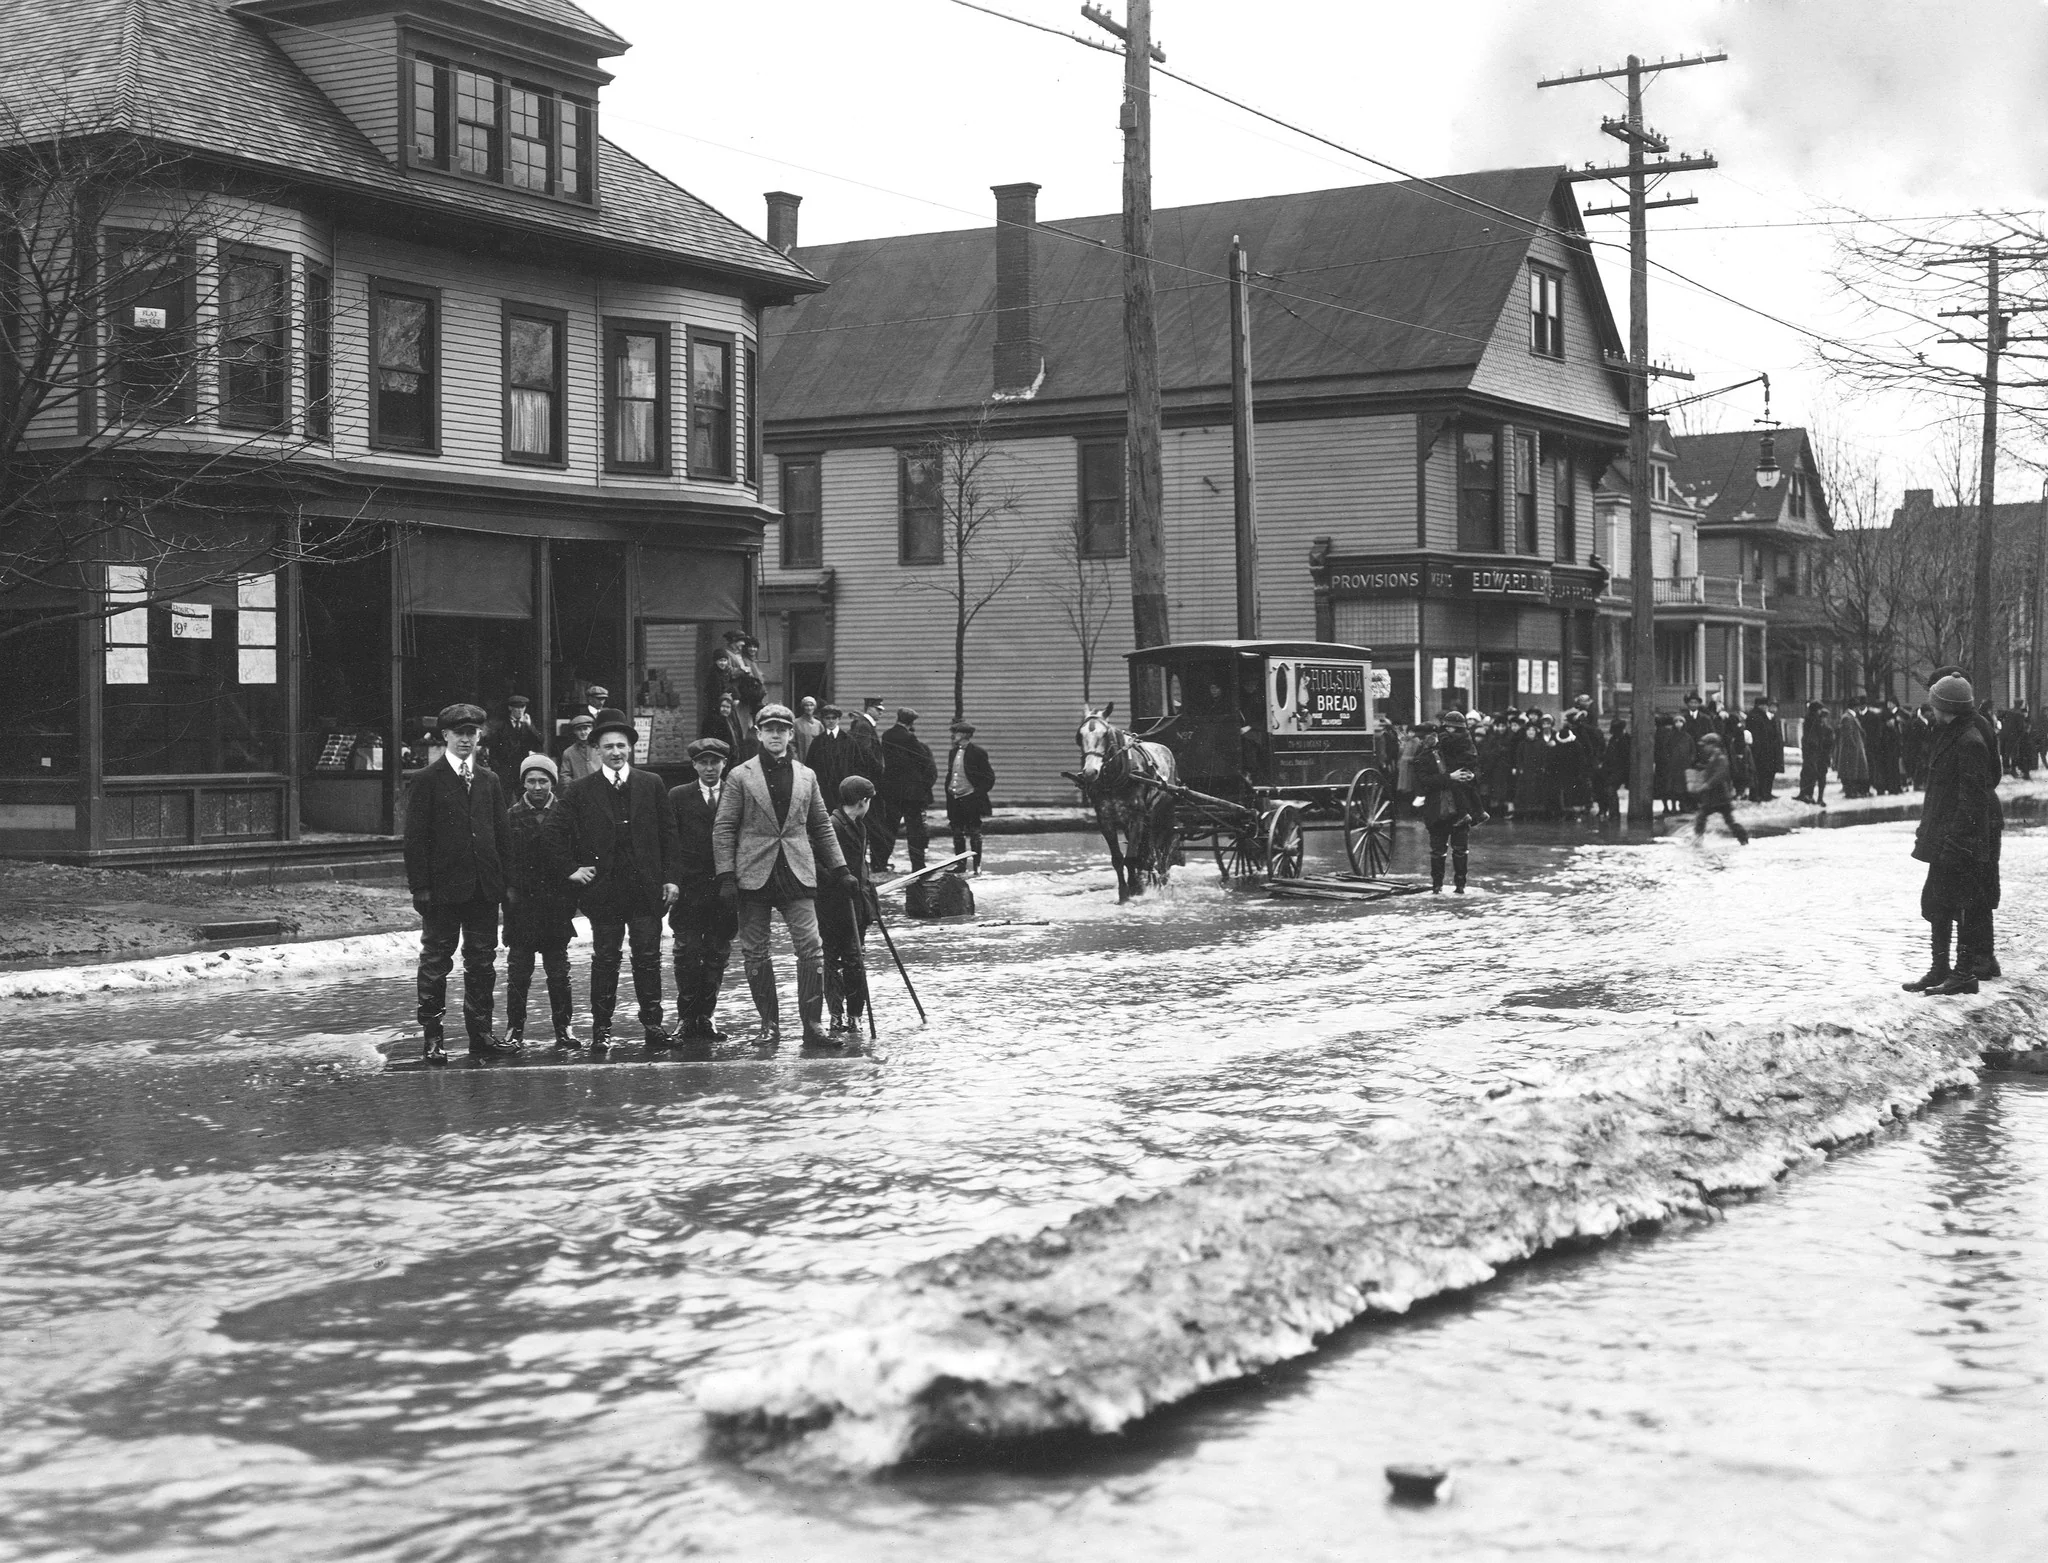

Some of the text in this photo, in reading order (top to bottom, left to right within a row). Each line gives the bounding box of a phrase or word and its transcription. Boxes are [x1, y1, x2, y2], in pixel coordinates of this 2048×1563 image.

[1331, 572, 1419, 589] PROVISIONS
[1472, 570, 1527, 590] EDWARD
[1317, 695, 1358, 711] BREAD
